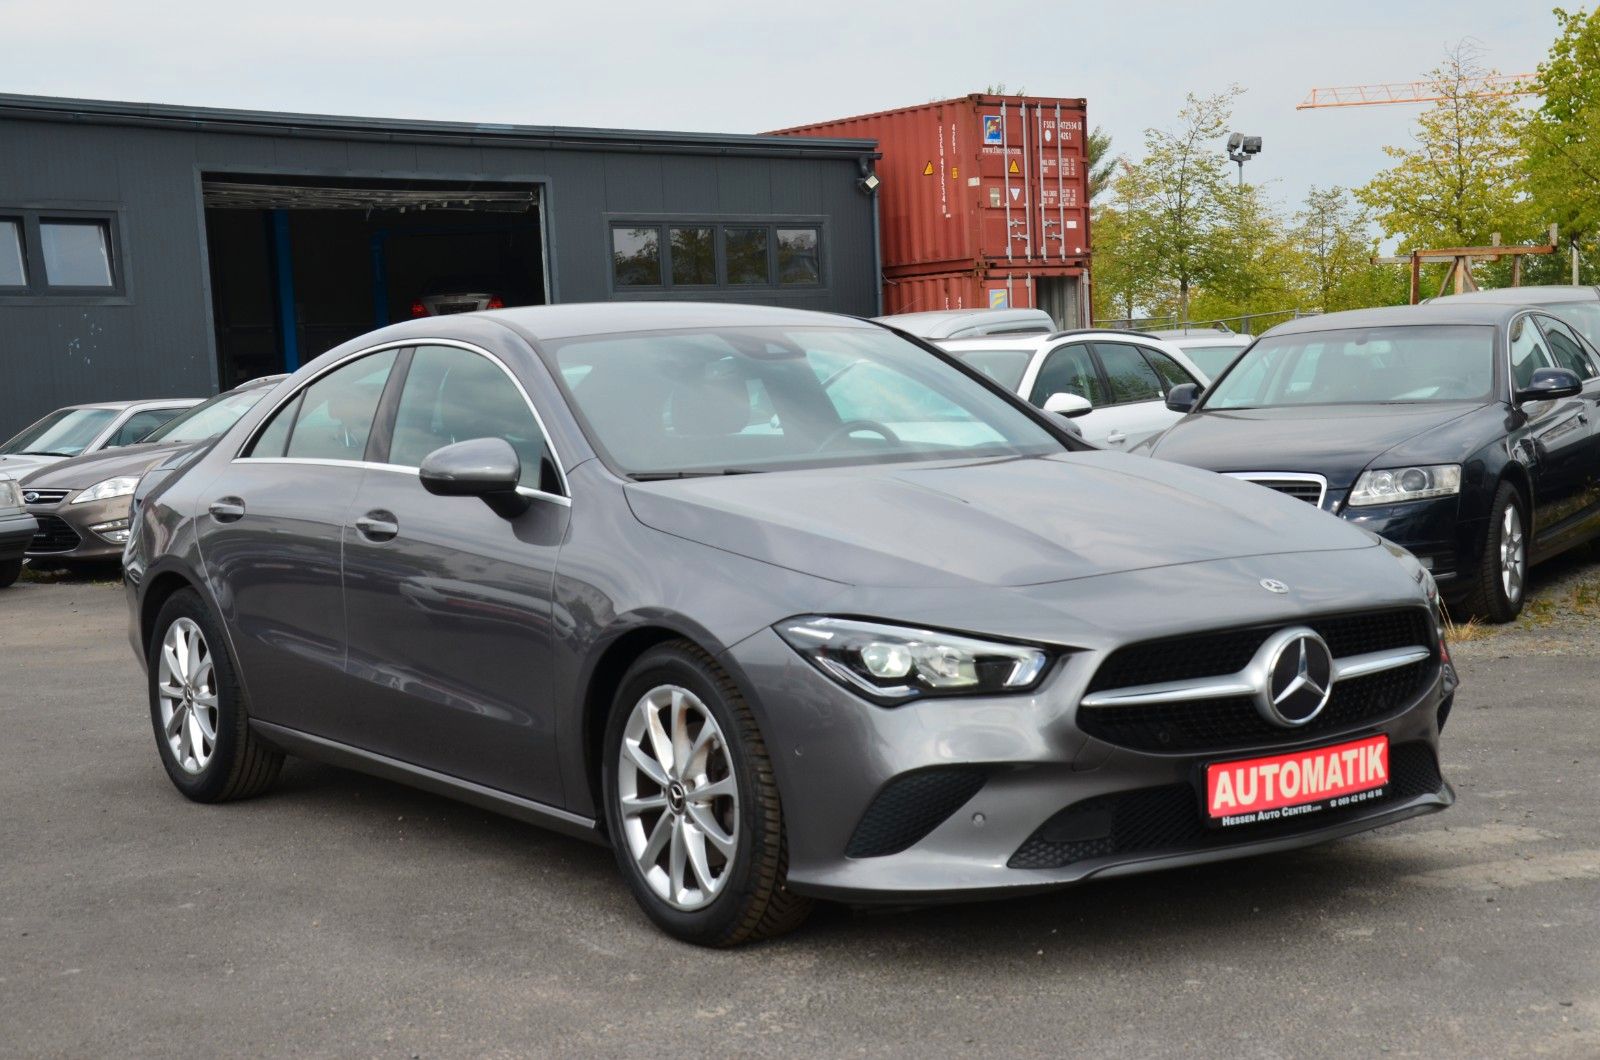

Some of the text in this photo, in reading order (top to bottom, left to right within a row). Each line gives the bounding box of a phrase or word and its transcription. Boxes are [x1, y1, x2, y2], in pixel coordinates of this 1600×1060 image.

[1213, 743, 1386, 810] AUTOMATIK
[1222, 814, 1256, 826] HESSEN
[1258, 811, 1281, 822] AUTO
